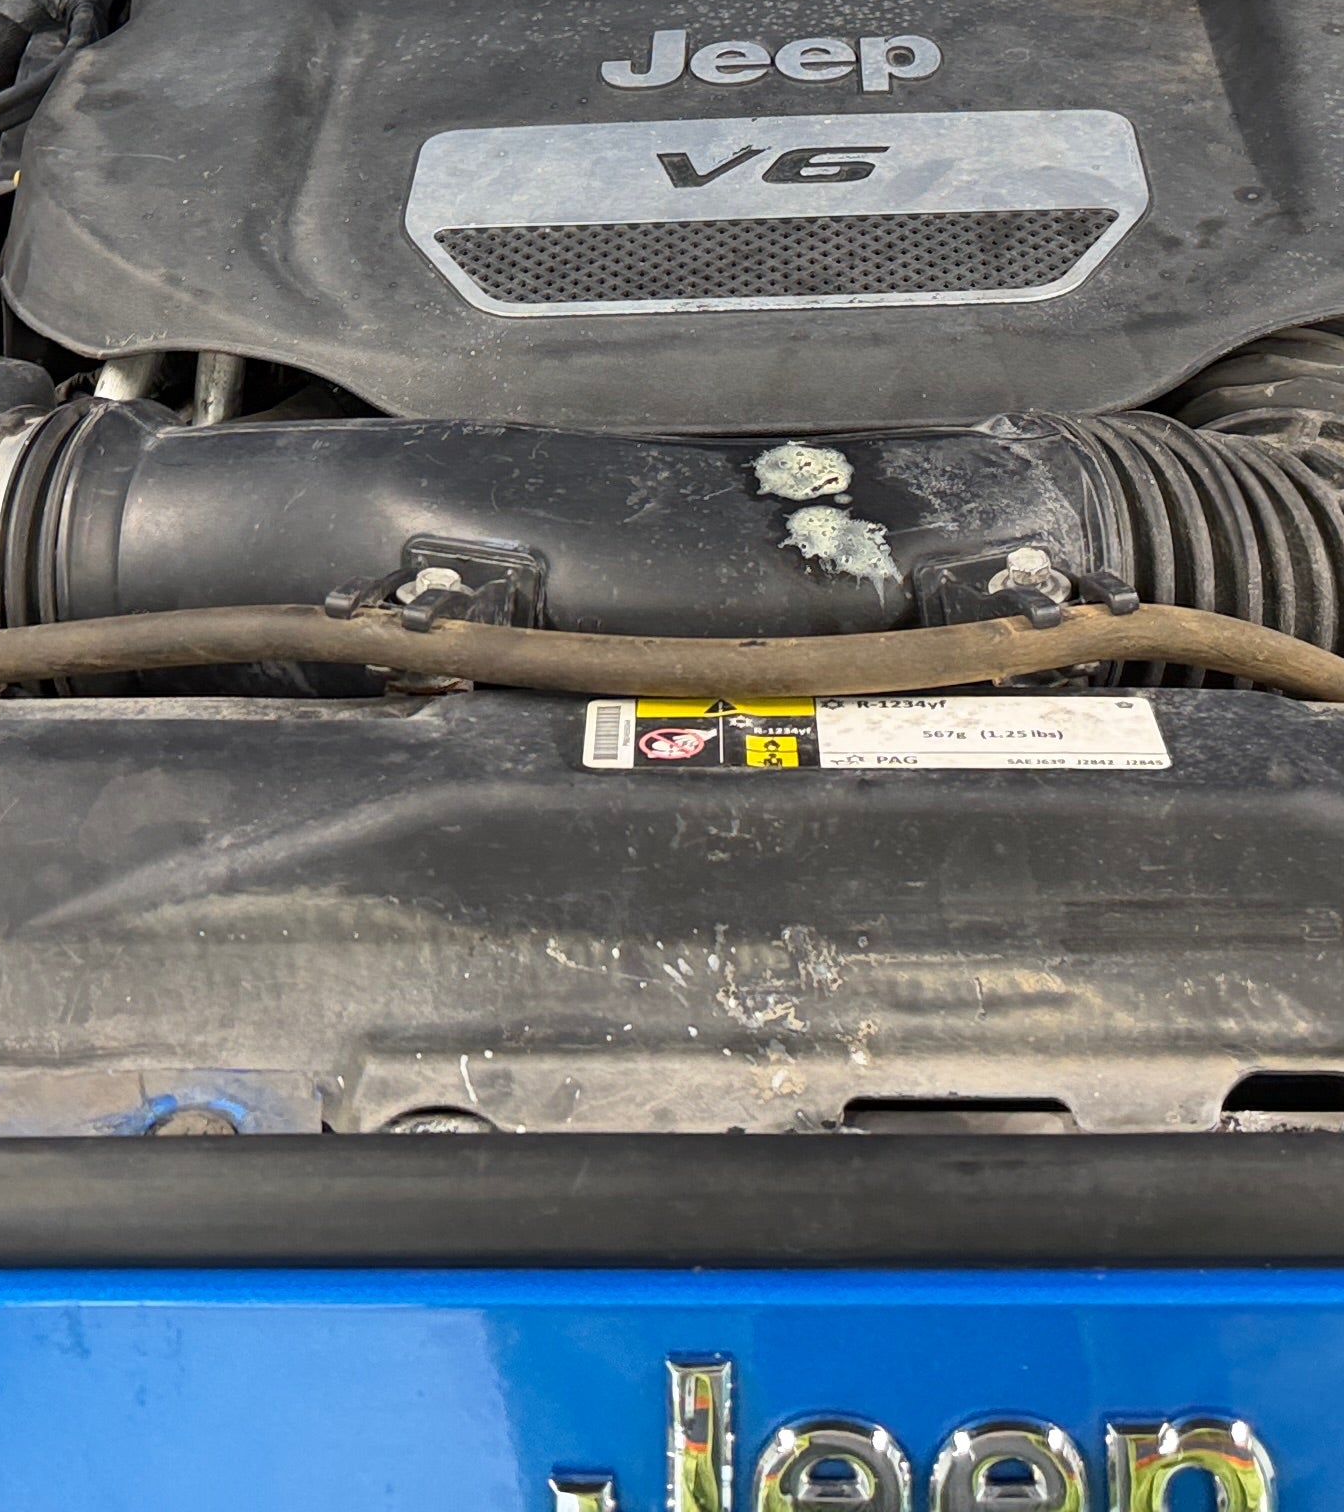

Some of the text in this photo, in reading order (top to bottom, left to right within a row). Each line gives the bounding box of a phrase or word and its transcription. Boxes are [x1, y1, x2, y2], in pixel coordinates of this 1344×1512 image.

[601, 28, 943, 92] Jeep
[656, 145, 891, 188] V6
[856, 700, 947, 710] R-1234yf
[922, 729, 1064, 740] 567g (1.25 lbs)
[876, 755, 918, 765] PAG
